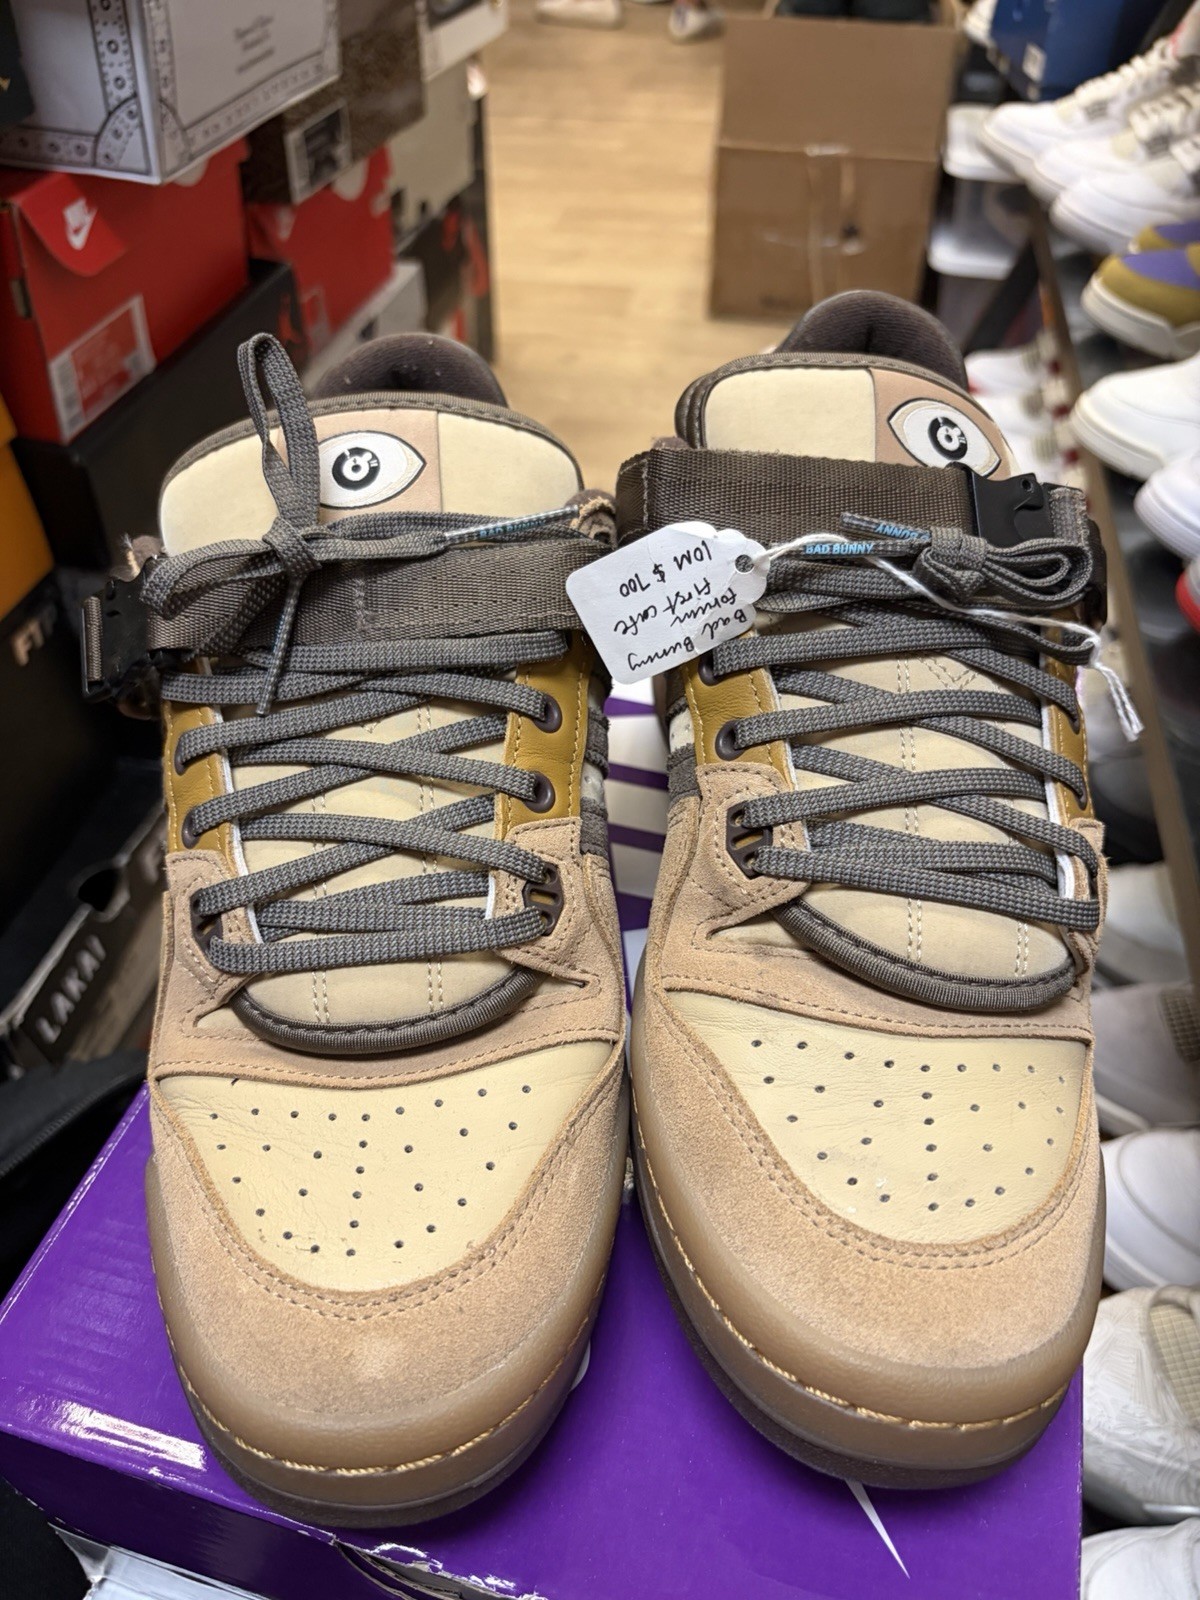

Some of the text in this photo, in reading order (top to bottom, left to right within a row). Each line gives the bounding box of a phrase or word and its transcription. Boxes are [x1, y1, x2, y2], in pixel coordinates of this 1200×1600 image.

[673, 540, 712, 571] 10M
[805, 542, 874, 555] BAD BUNNY
[613, 604, 658, 636] cafe
[627, 609, 747, 672] Bad Bunny
[35, 934, 107, 1044] LAKAI
